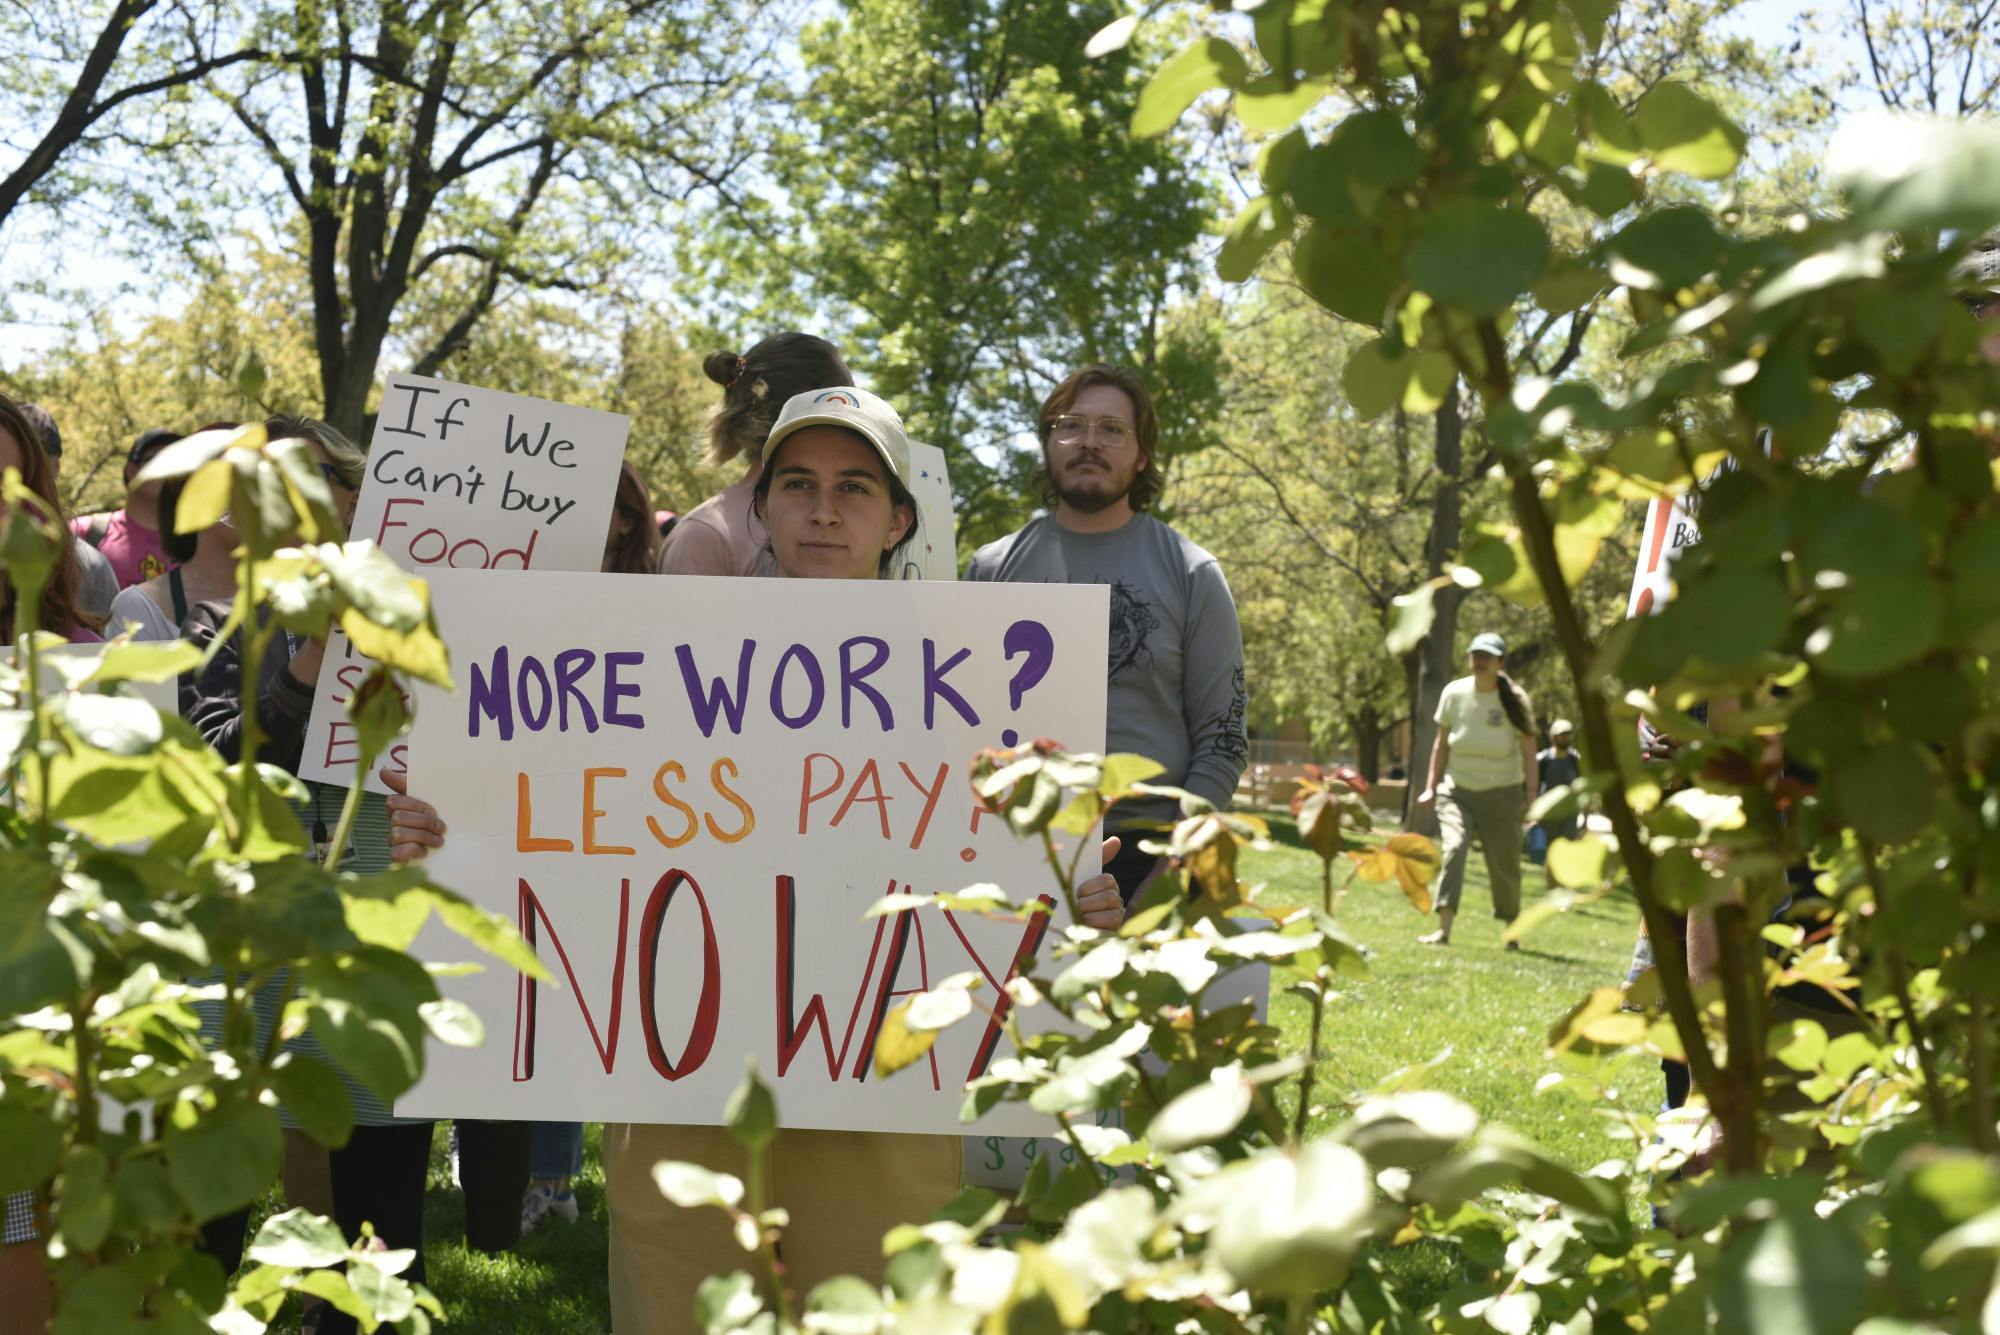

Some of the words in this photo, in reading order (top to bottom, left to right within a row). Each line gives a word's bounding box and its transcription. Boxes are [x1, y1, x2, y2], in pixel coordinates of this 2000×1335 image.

[383, 383, 470, 440] If
[504, 414, 577, 468] We
[373, 450, 486, 504] Can't
[500, 470, 577, 525] buy
[376, 498, 539, 570] Food
[468, 645, 645, 741] MORE
[675, 619, 1054, 748] WORK?
[516, 757, 755, 855] LESS
[513, 868, 721, 1082] NO
[776, 874, 1057, 1092] WAY
